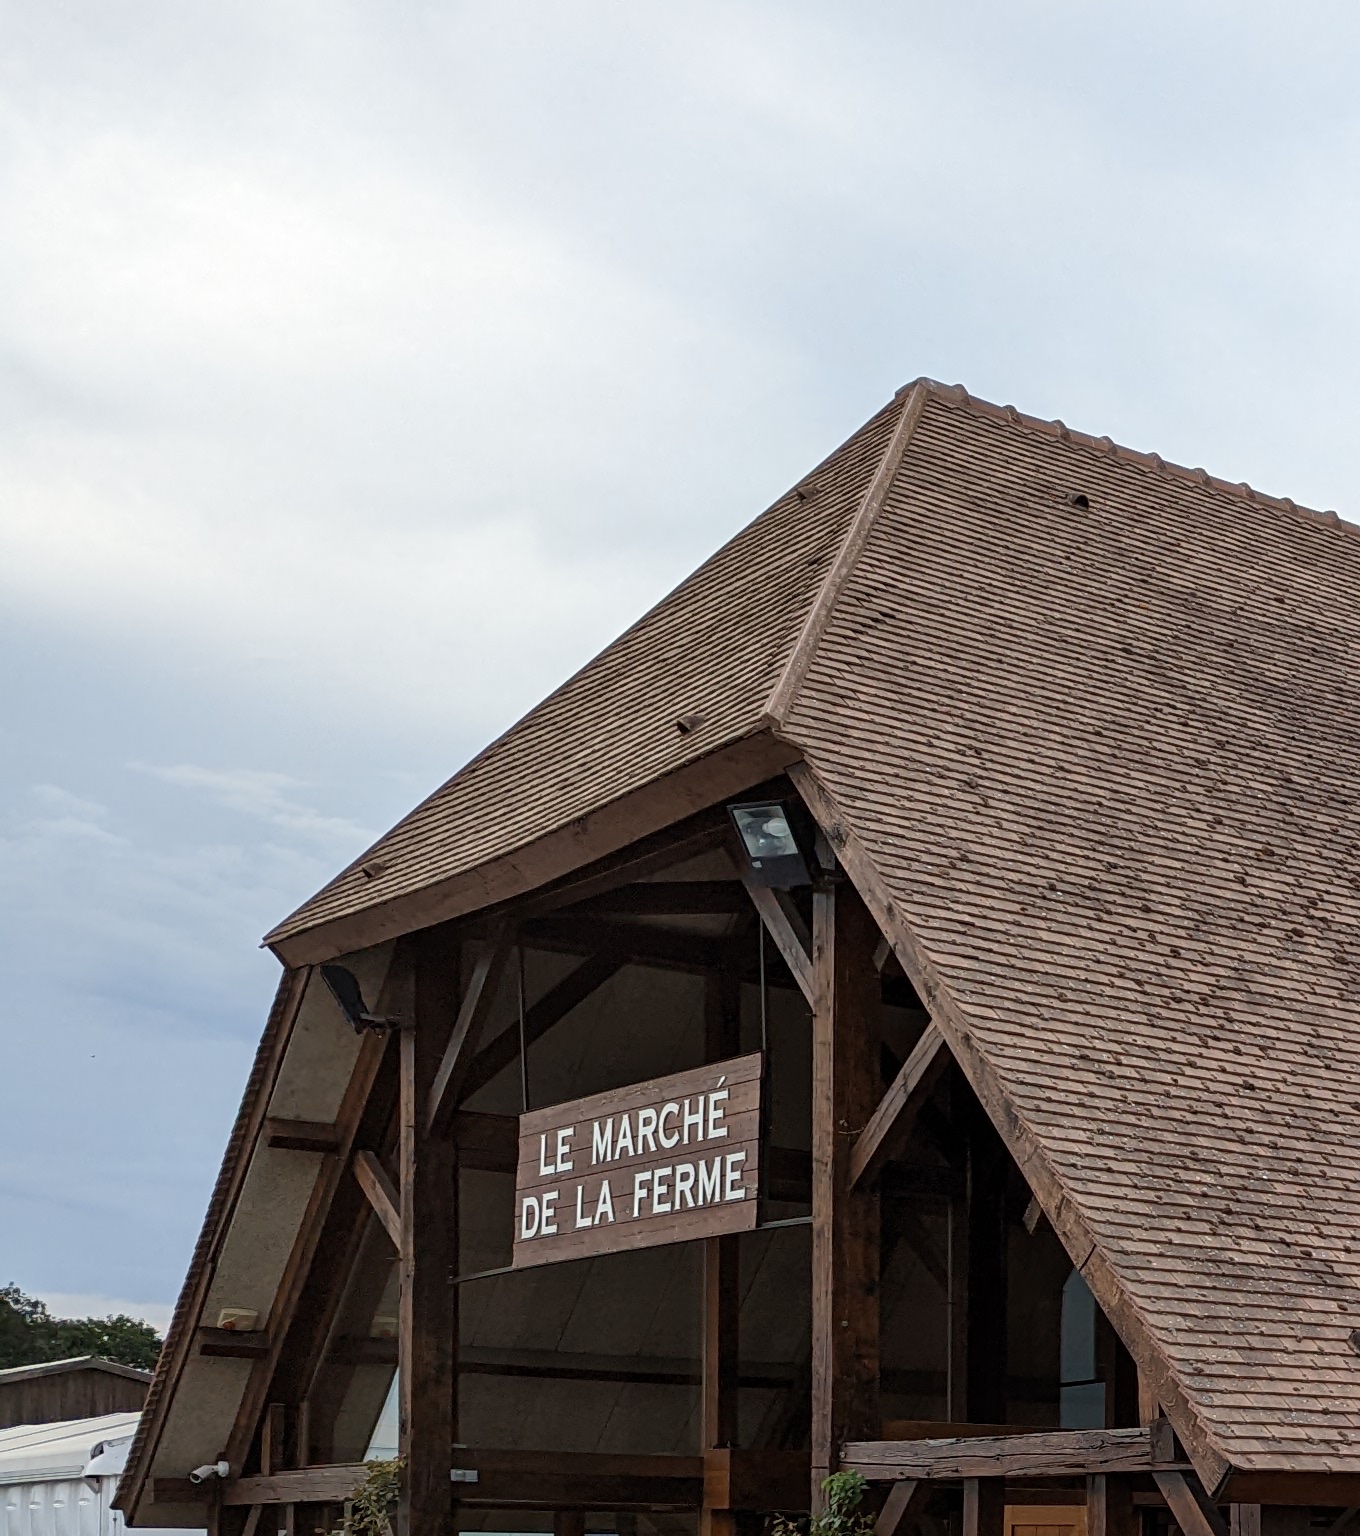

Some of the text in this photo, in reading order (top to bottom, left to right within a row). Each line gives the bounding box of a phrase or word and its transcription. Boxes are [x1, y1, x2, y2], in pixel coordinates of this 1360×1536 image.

[538, 1075, 730, 1176] LE MARCHÉ
[520, 1149, 746, 1240] DE LA FERME
